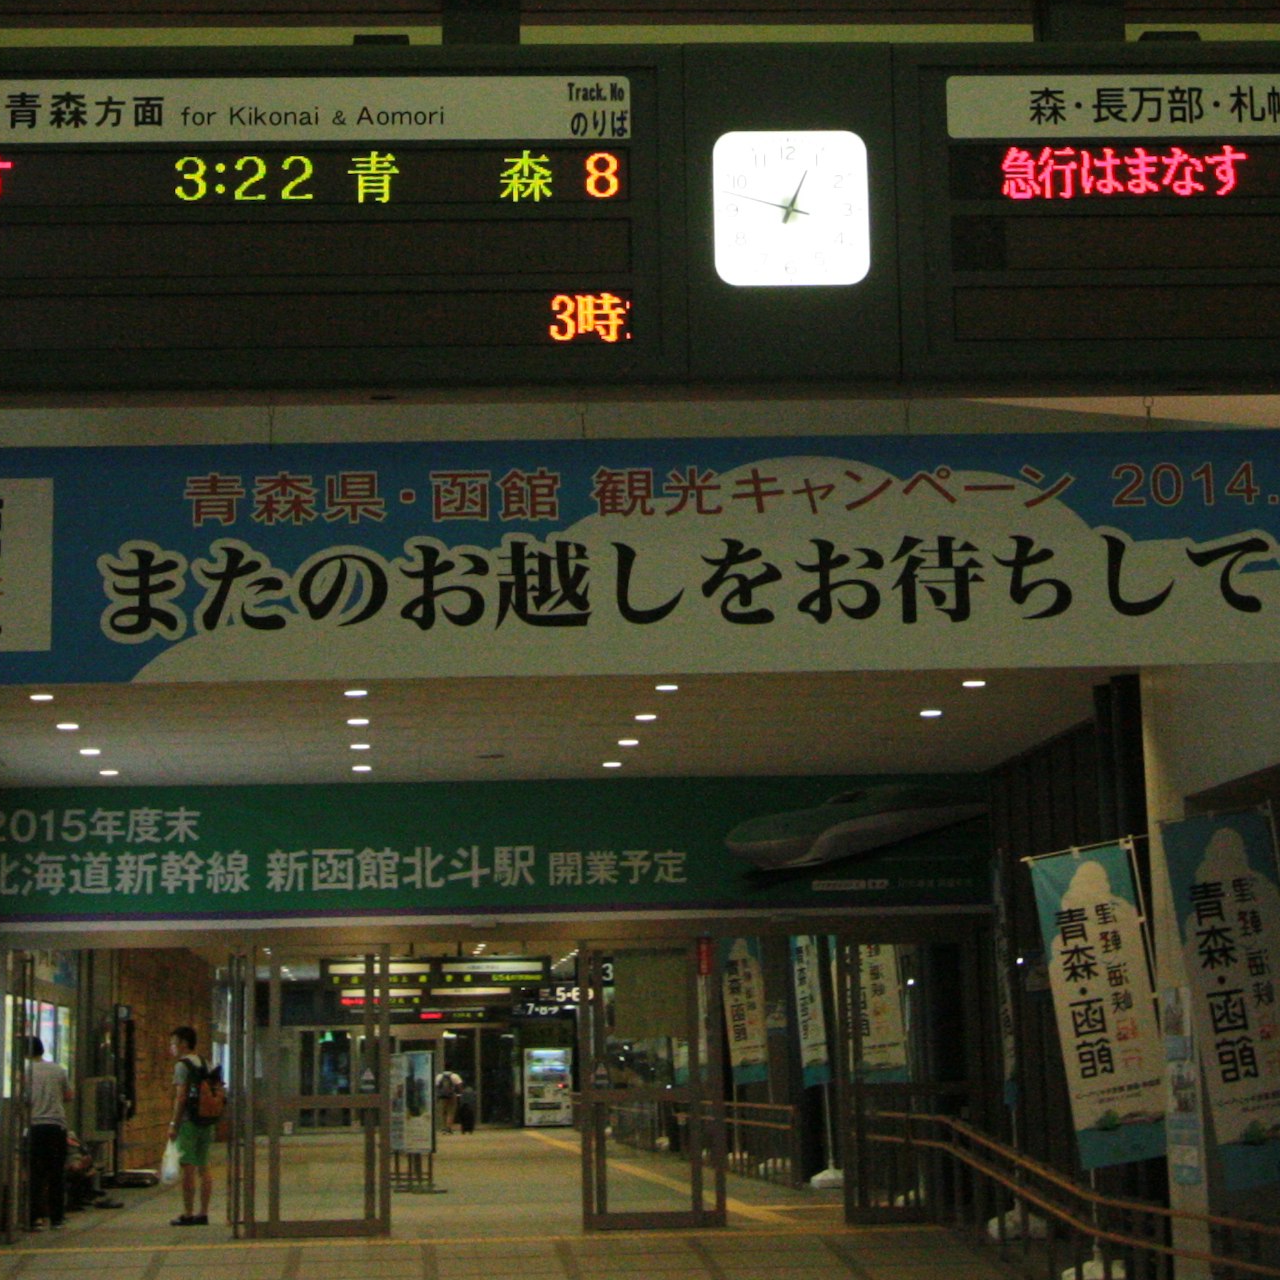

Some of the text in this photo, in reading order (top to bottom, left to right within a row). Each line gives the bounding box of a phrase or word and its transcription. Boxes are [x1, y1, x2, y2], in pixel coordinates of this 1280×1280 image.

[181, 106, 216, 126] for
[229, 105, 319, 126] Kikonai
[332, 111, 346, 126] &
[357, 105, 445, 126] Aomori
[571, 110, 629, 137] のりば
[780, 146, 796, 160] 12
[174, 155, 314, 202] 3:22
[584, 151, 619, 199] 8
[733, 175, 748, 189] 10
[833, 175, 843, 188] 2
[1001, 145, 1247, 200] 急行はまなす
[844, 204, 853, 217] 3
[184, 467, 560, 525] 青森県・函館
[592, 462, 1077, 520] 観光キャンペーン
[266, 844, 537, 893] 新函館北斗駅
[547, 848, 687, 886] 開業予定
